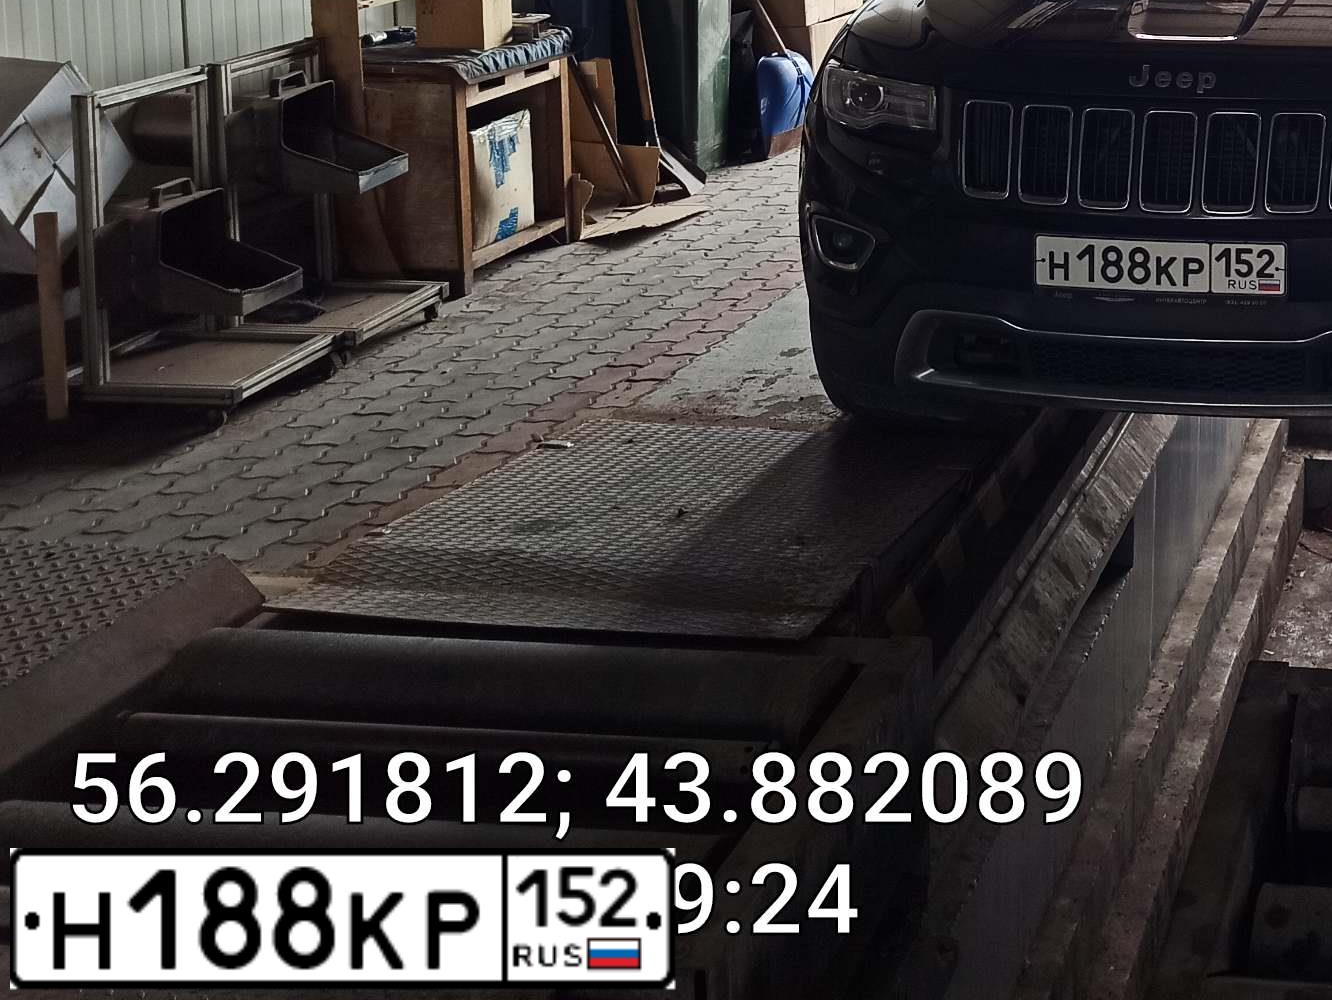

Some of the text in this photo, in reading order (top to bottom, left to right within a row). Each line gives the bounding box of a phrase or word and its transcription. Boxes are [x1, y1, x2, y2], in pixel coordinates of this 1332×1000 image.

[1129, 64, 1217, 94] Jeep
[1214, 247, 1275, 279] 152
[1227, 279, 1257, 290] RUS
